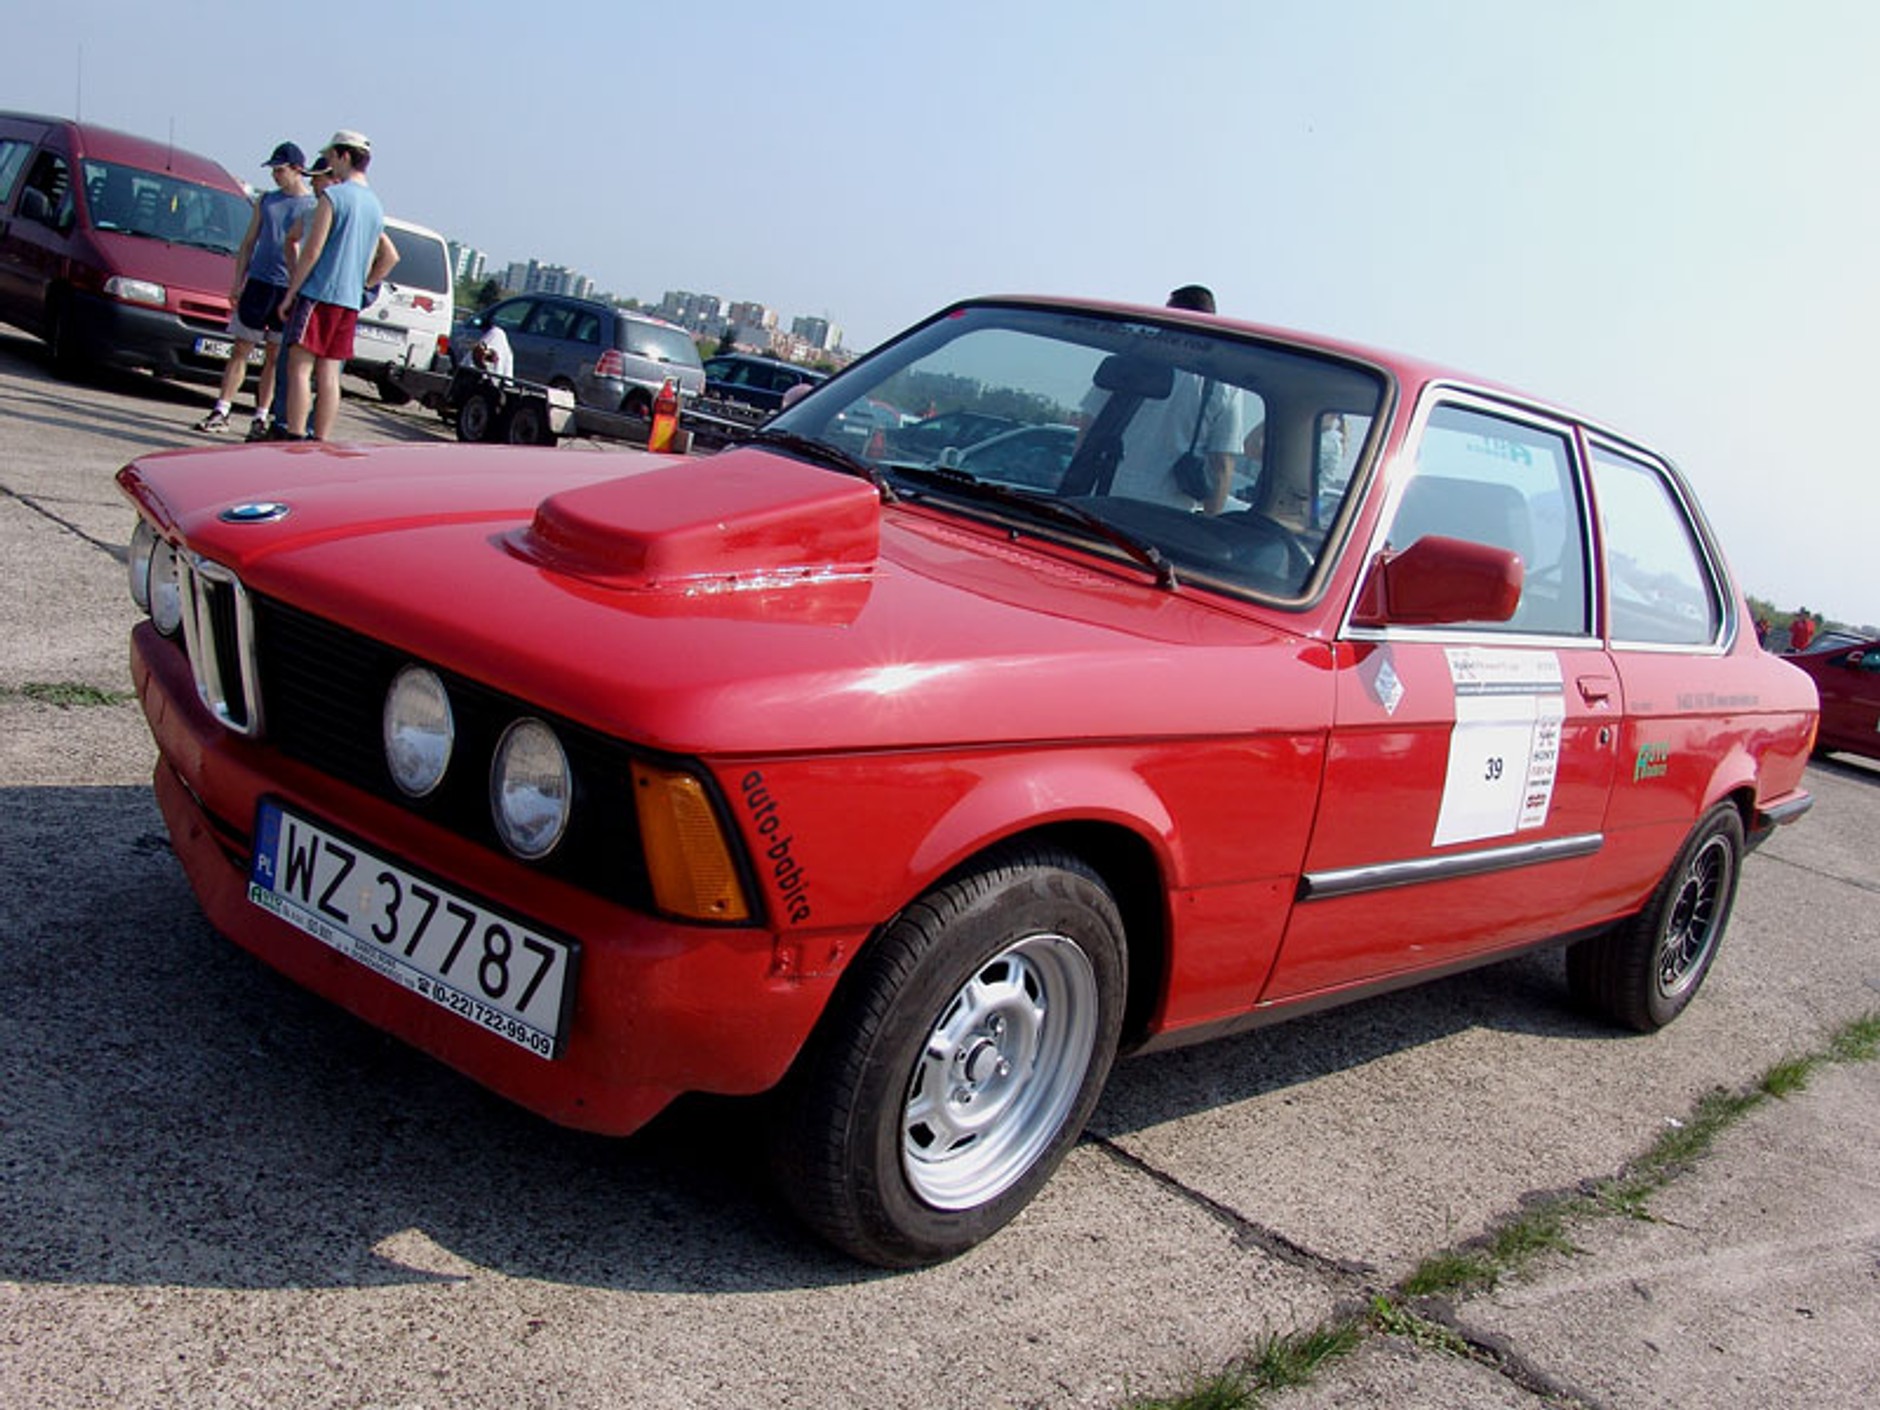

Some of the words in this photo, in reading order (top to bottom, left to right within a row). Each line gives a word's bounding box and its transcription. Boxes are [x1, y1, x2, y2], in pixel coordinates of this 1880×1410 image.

[1485, 758, 1503, 781] 39
[257, 853, 273, 878] PL
[741, 770, 811, 925] auto-babice
[284, 823, 356, 925] WZ
[371, 871, 556, 1013] 37787
